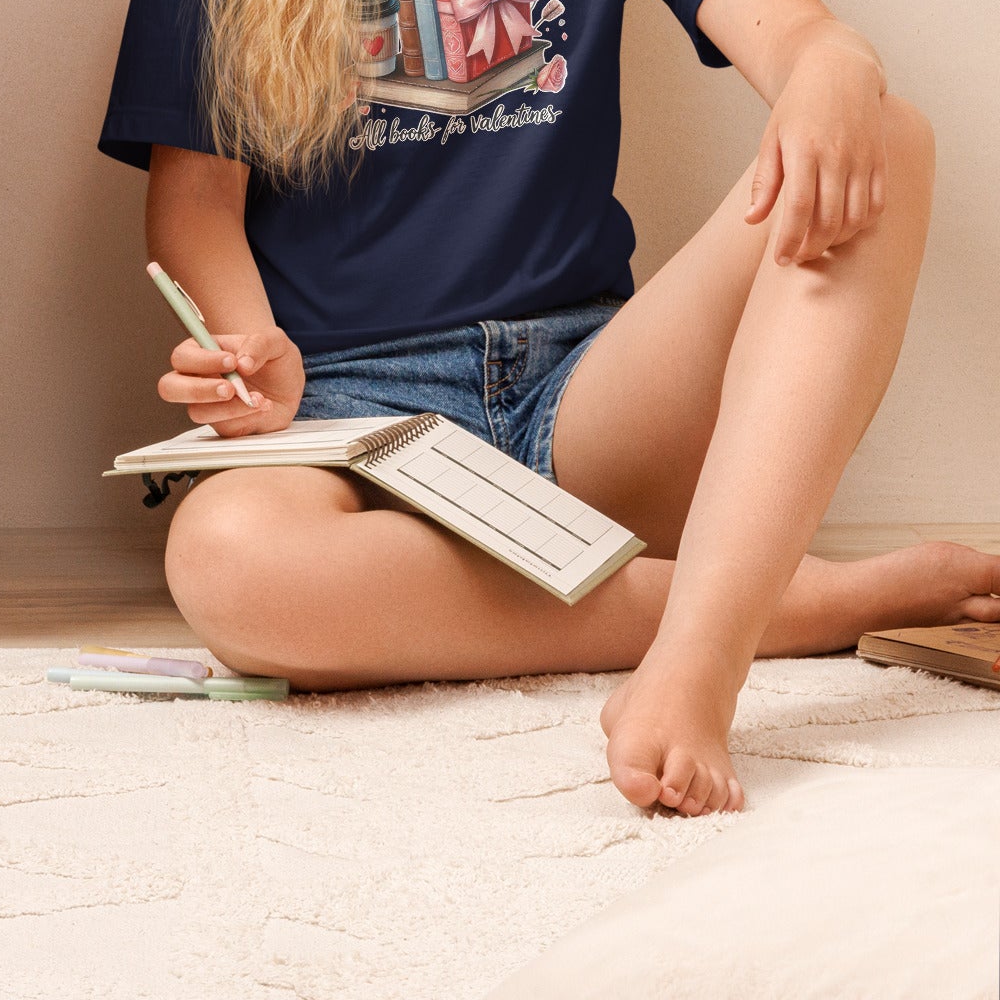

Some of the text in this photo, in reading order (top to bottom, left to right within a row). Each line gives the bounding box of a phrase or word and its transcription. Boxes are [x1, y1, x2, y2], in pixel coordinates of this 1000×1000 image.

[349, 118, 388, 150] All
[389, 114, 442, 144] books
[441, 115, 467, 145] for
